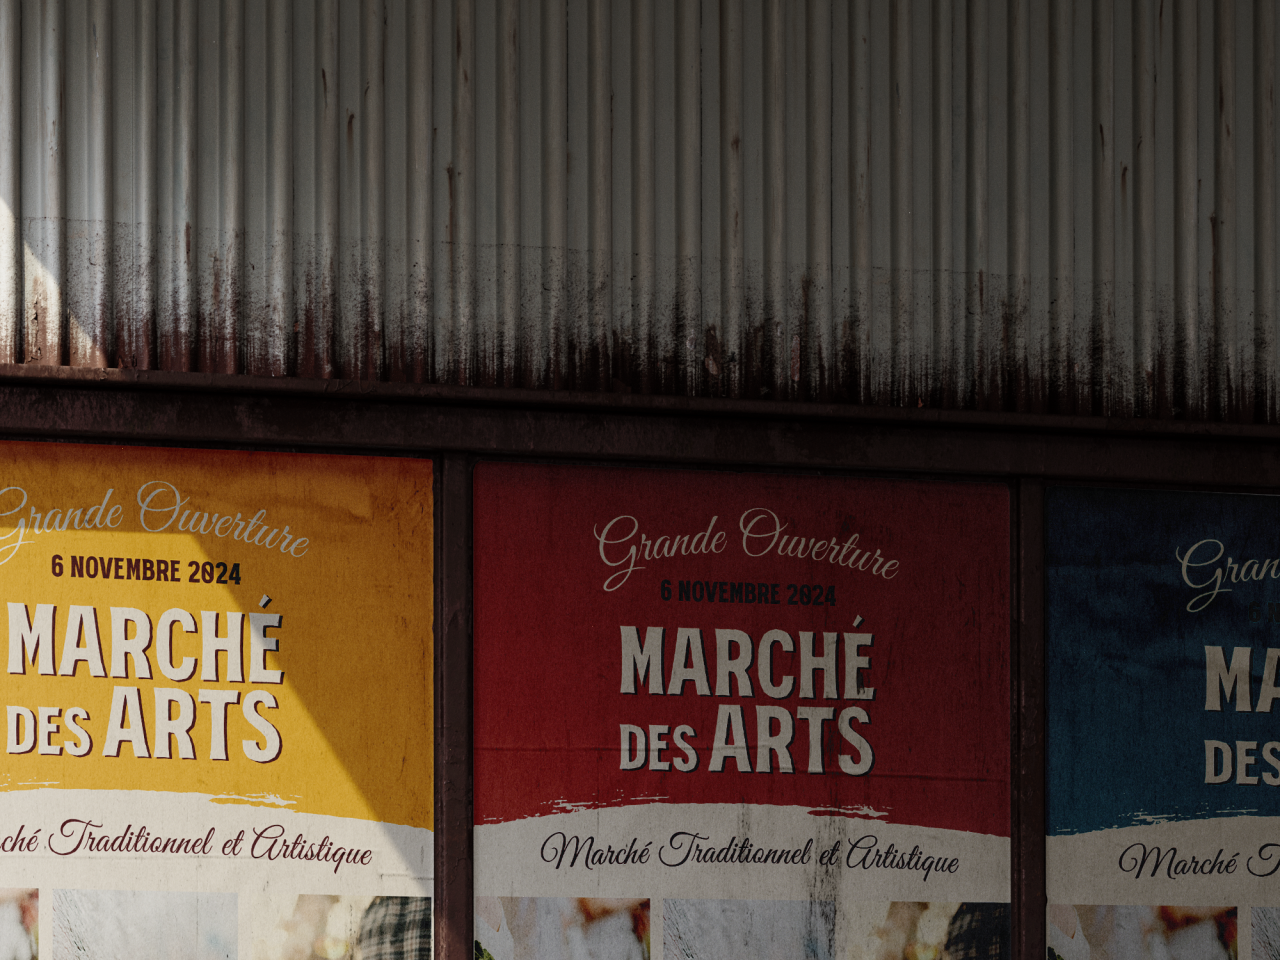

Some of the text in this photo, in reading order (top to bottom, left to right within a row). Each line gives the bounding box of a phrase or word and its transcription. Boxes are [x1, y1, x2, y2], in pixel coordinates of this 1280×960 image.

[137, 481, 309, 558] Ouverture
[594, 507, 900, 591] Grande Ouverture
[51, 554, 241, 585] 6 NOVEMBRE 2024
[660, 579, 837, 607] 6 NOVEMBRE 2024
[7, 594, 284, 684] MARCHÉ
[620, 615, 875, 701] MARCHÉ
[6, 686, 283, 763] DES ARTS
[620, 704, 875, 776] DES ARTS
[49, 820, 213, 856] Traditionnel
[222, 829, 243, 857] et
[251, 825, 373, 873] Artistique
[540, 832, 959, 882] Marché Traditionnel et Artistique
[1119, 843, 1239, 880] Marché
